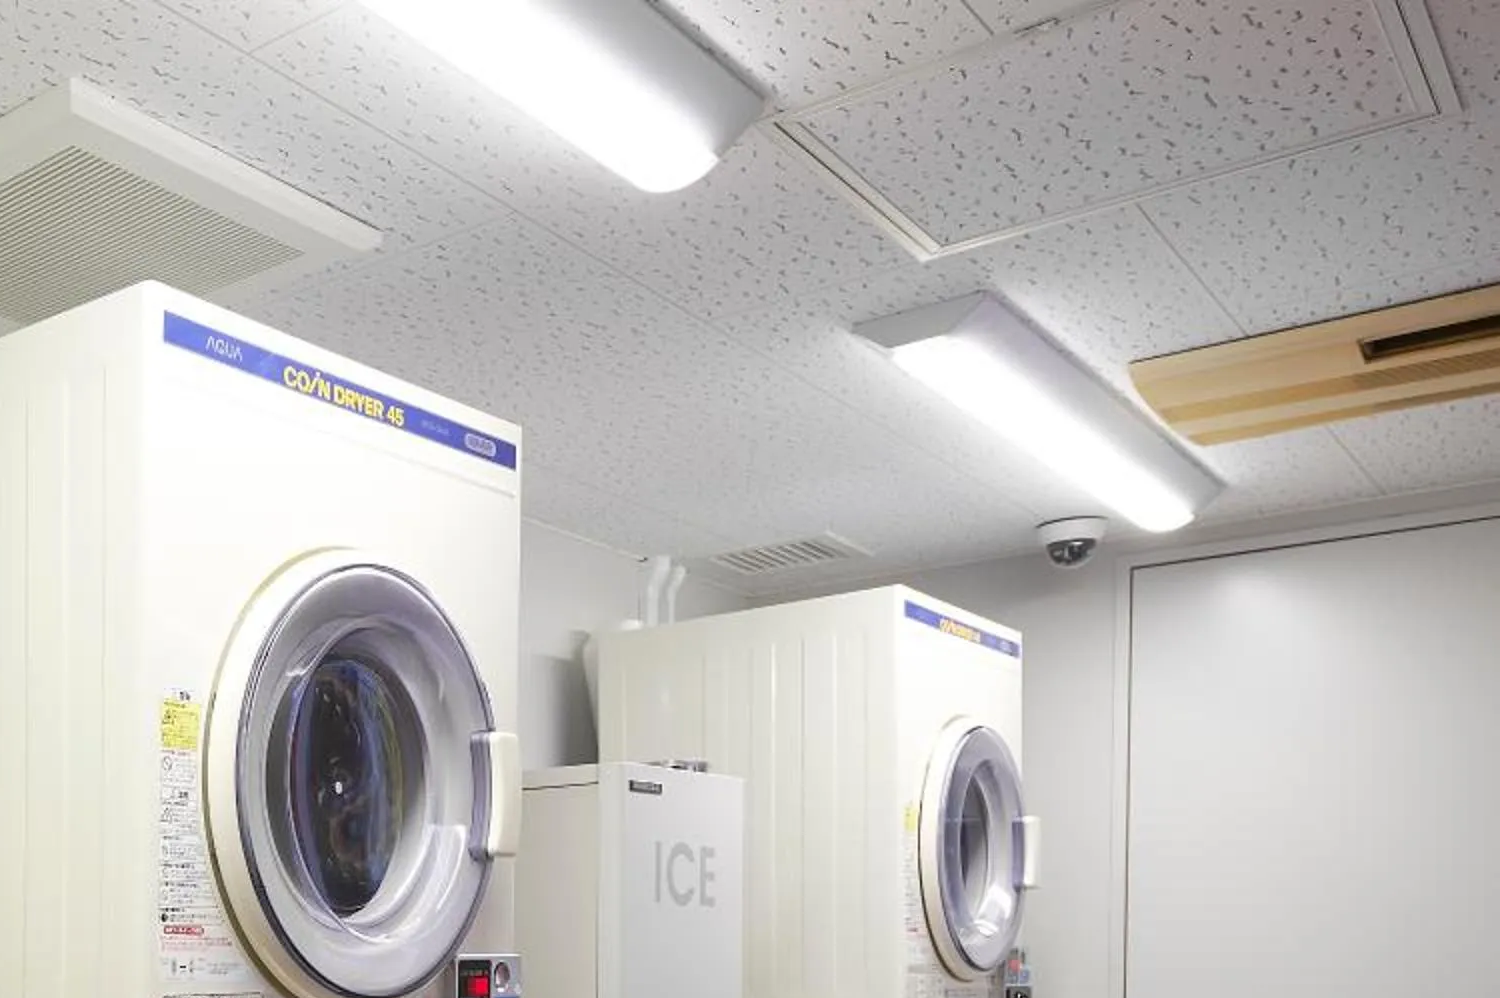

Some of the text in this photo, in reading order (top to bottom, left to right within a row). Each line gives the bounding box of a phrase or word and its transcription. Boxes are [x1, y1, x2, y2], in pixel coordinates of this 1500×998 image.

[334, 387, 384, 420] DRYER
[387, 405, 405, 427] 45
[655, 841, 716, 908] ICE
